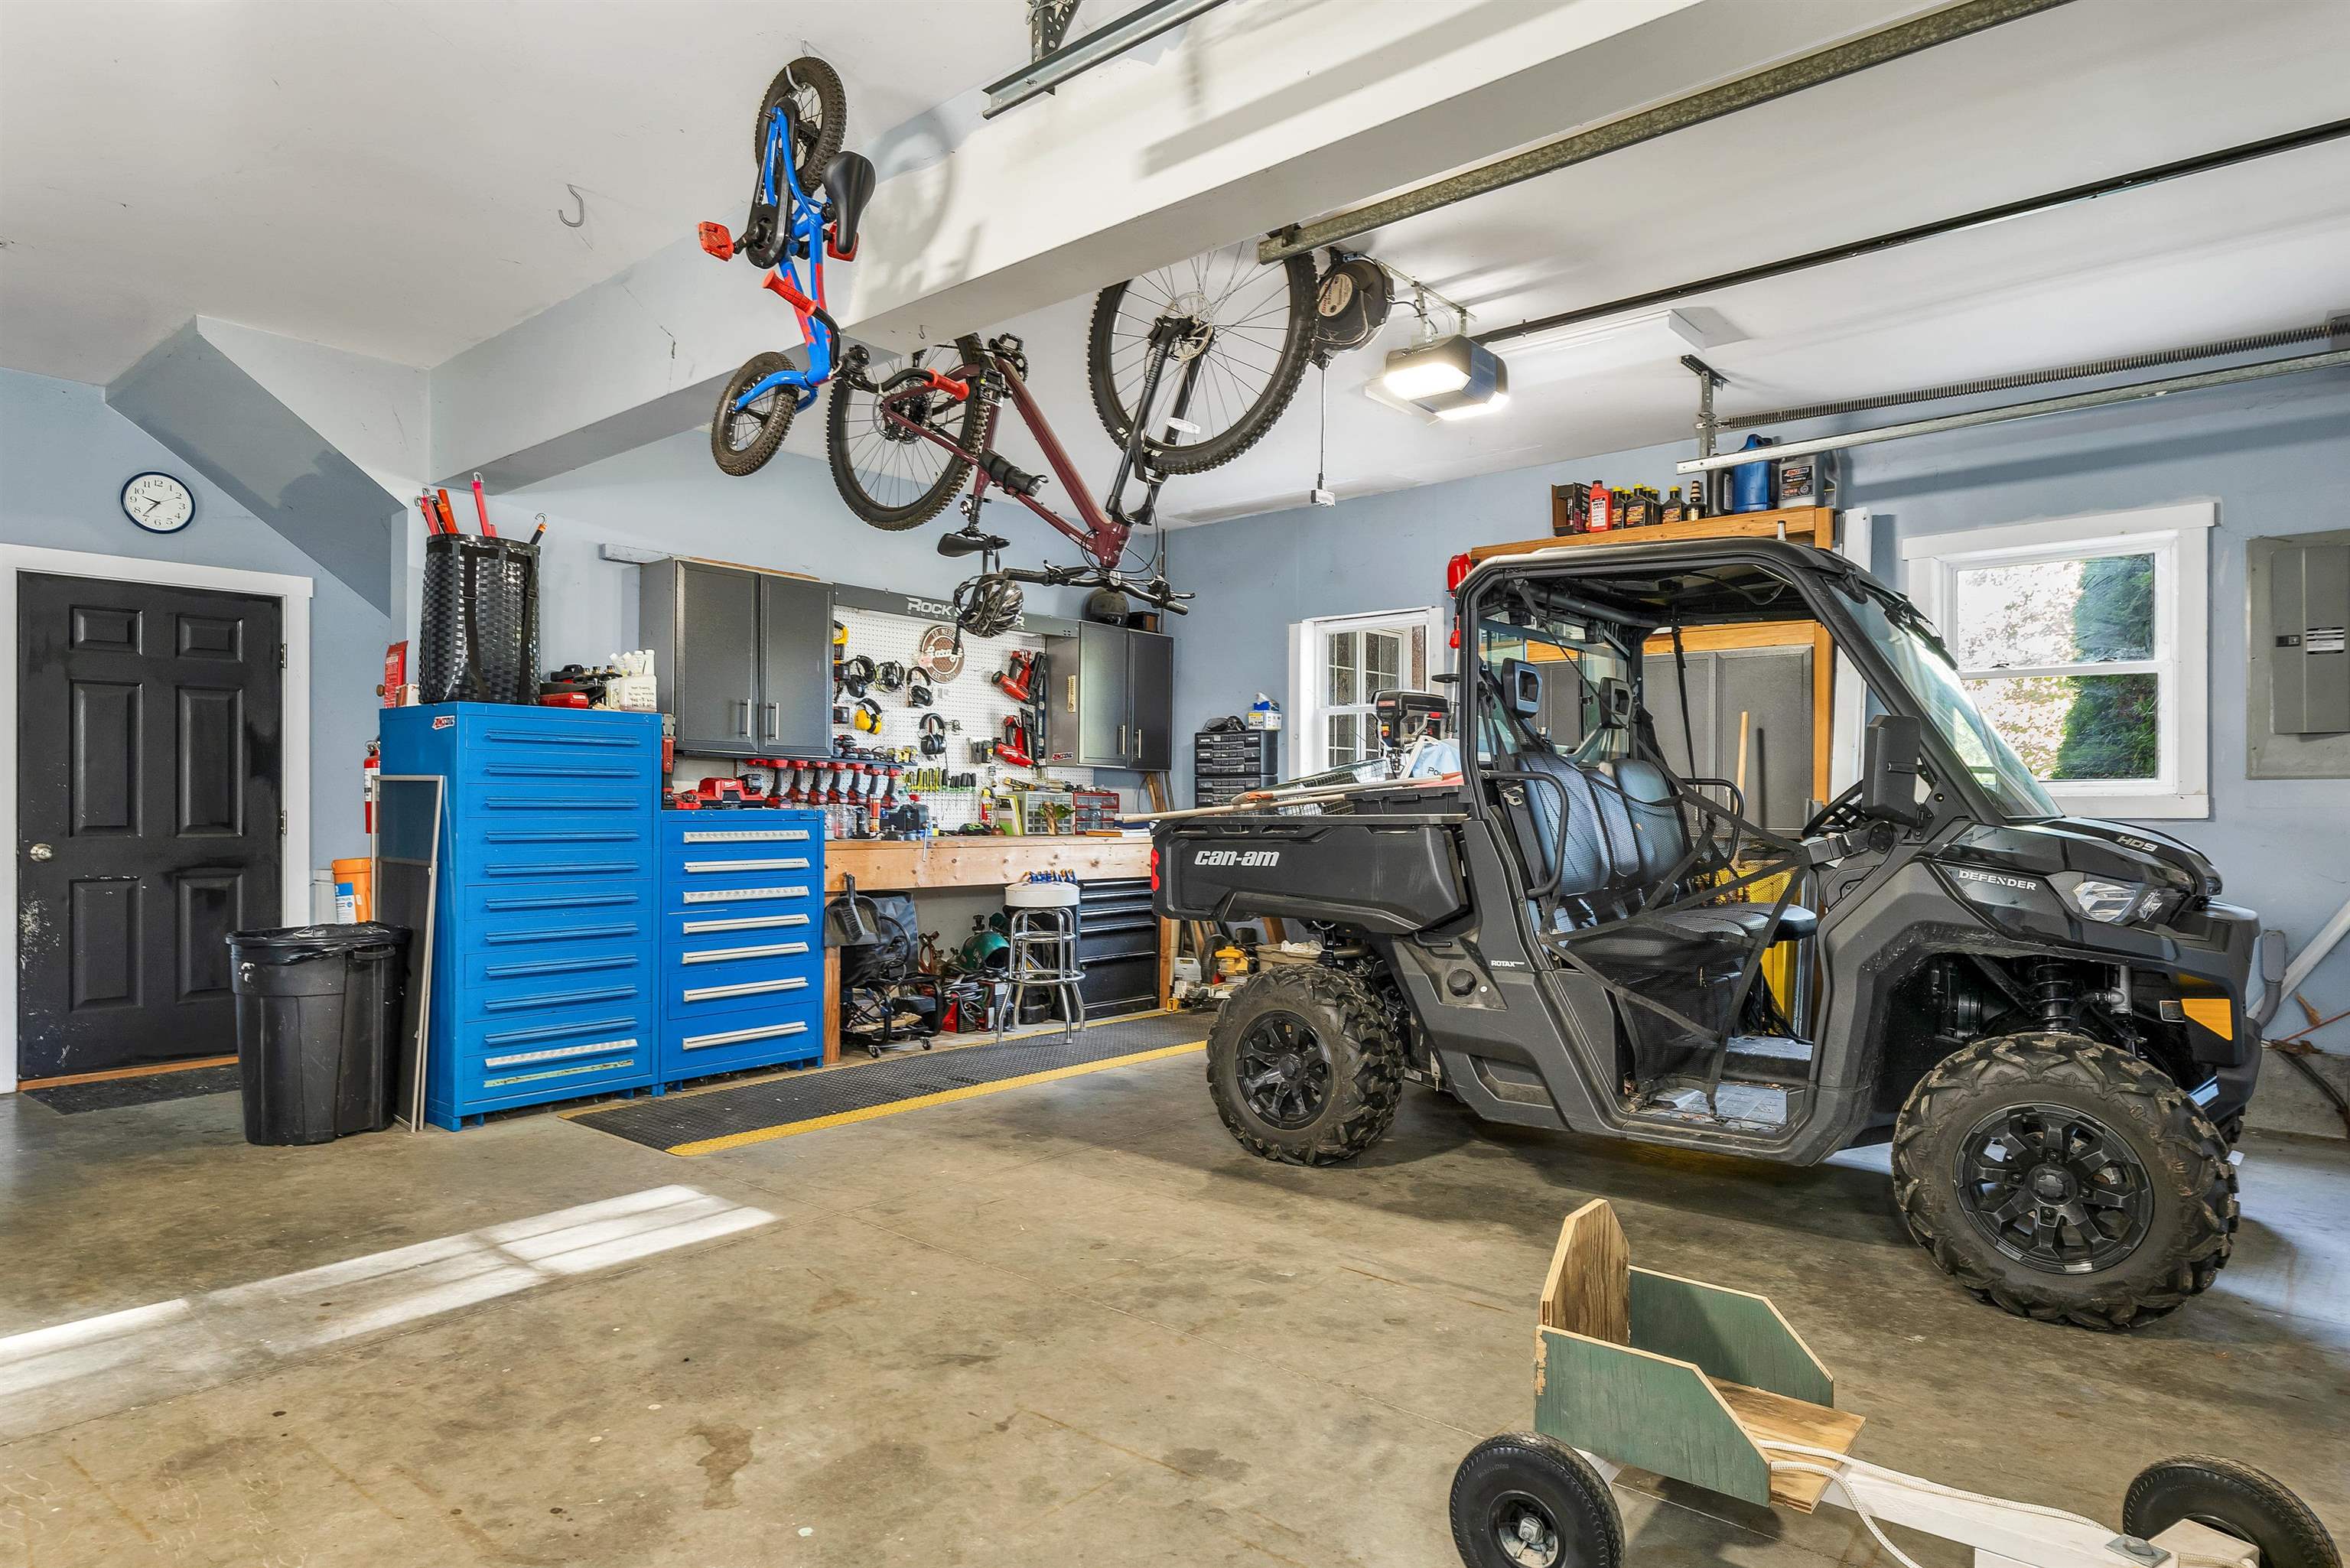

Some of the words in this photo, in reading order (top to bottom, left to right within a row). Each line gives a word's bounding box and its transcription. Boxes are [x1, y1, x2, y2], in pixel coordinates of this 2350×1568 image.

[905, 597, 954, 616] ROCK
[2117, 835, 2159, 852] HD9
[1194, 851, 1280, 867] can-am
[1958, 869, 2037, 891] DEFENDER
